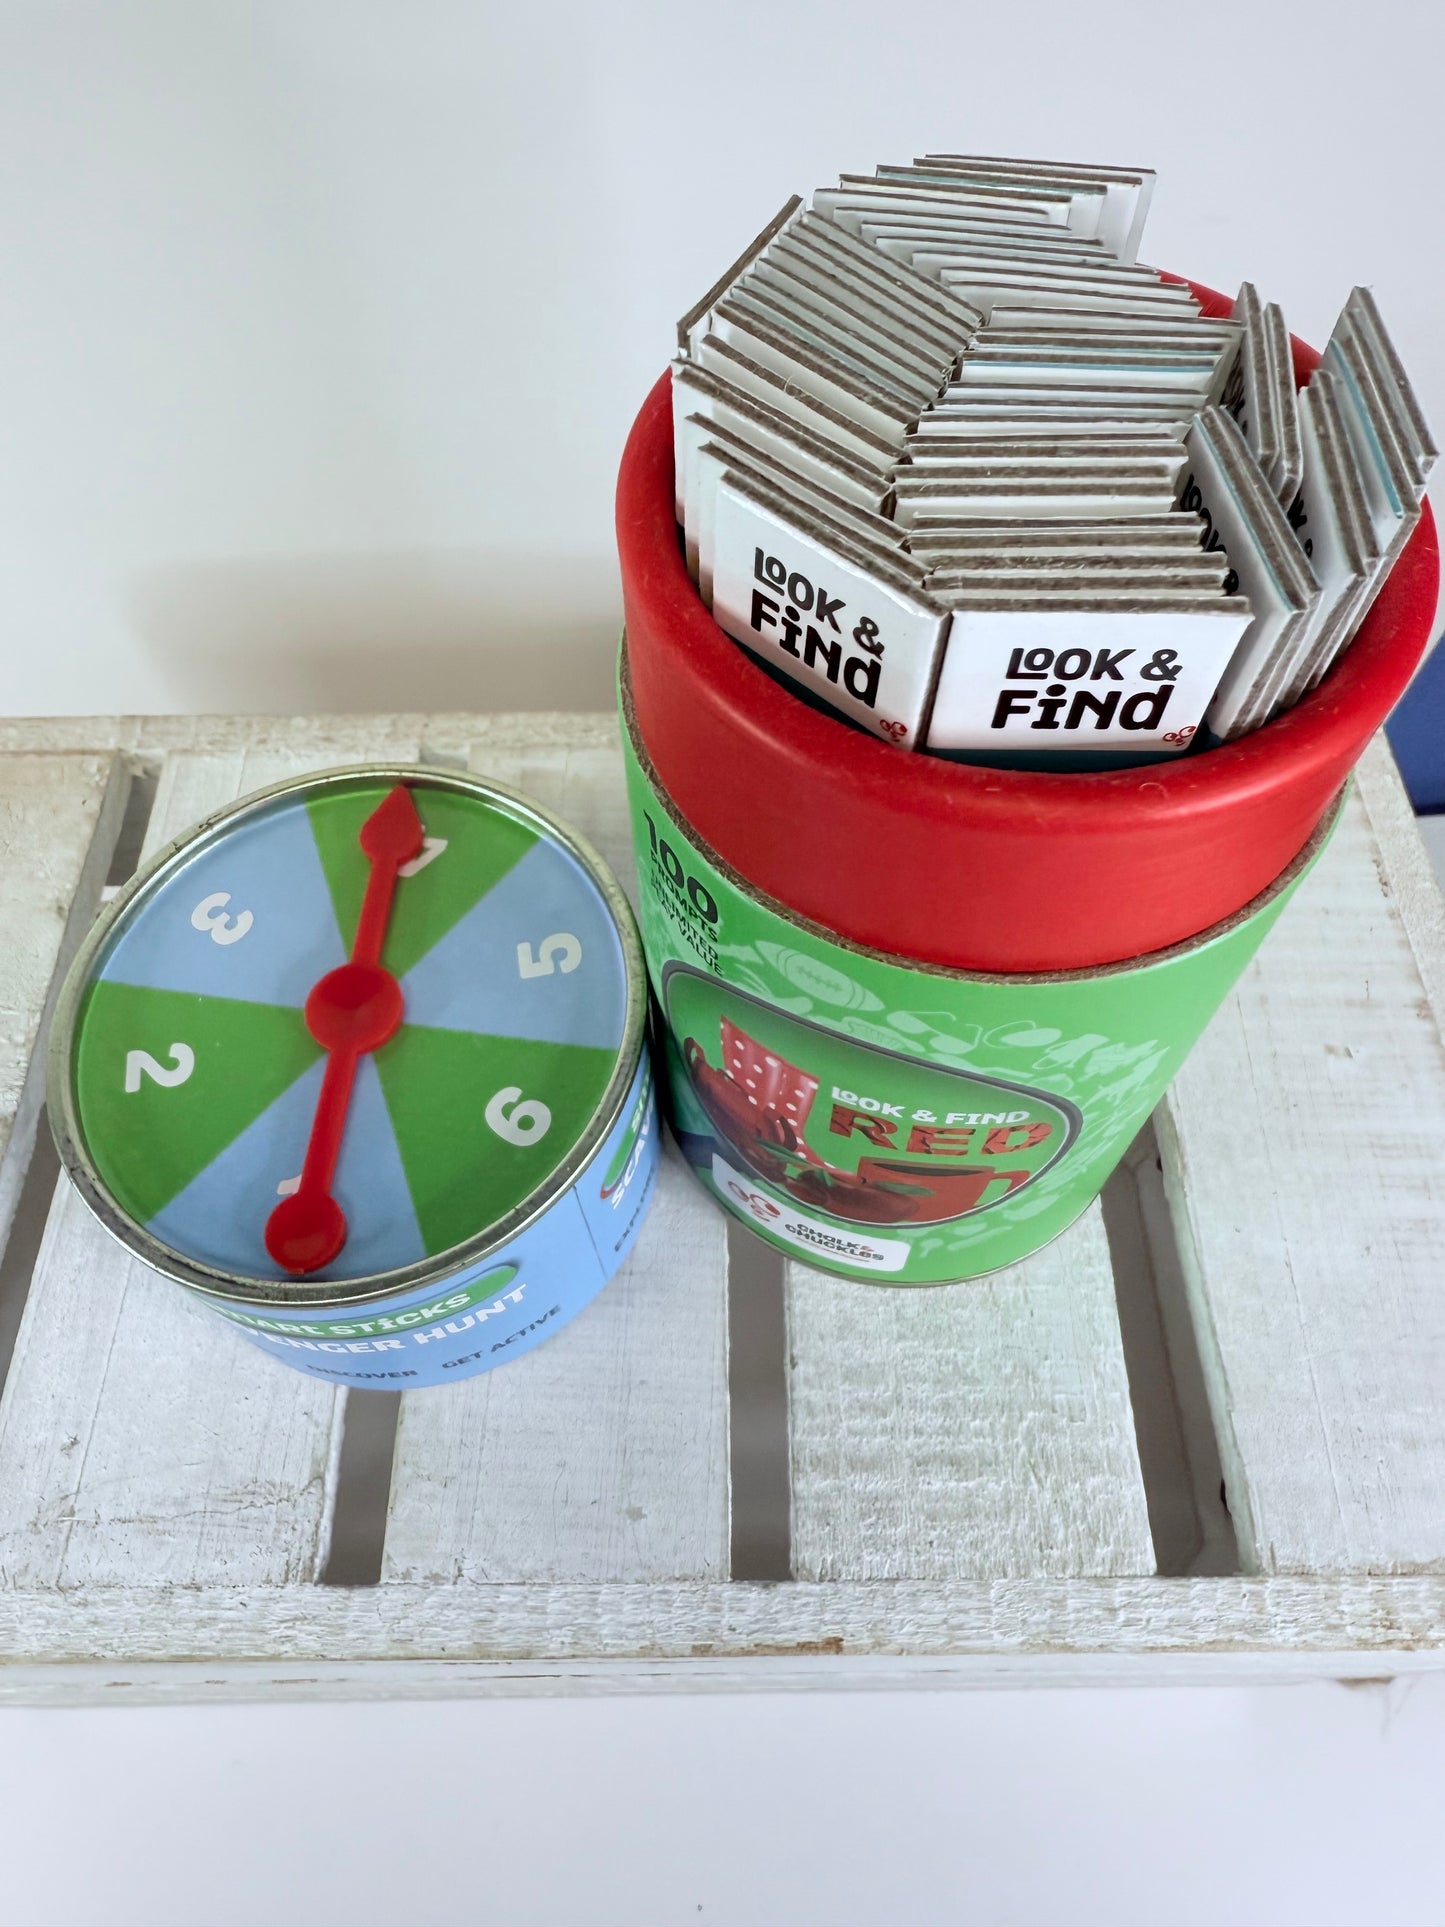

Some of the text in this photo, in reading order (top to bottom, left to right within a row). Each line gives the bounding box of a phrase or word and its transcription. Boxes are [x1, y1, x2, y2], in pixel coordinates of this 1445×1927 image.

[754, 546, 885, 660] LOOK &
[1005, 647, 1183, 681] LOOK &
[643, 808, 719, 924] 100
[190, 892, 254, 946] 3
[650, 850, 719, 944] PROMPTS
[516, 932, 583, 980] 5
[677, 924, 725, 977] VALUE
[125, 1042, 195, 1093] 2
[484, 1086, 552, 1147] 6
[829, 1103, 1054, 1156] RED
[831, 1086, 1030, 1125] LOOK & FIND
[416, 1284, 527, 1346] HUNT
[441, 1350, 484, 1369] GET
[490, 1304, 562, 1353] ACTIVE
